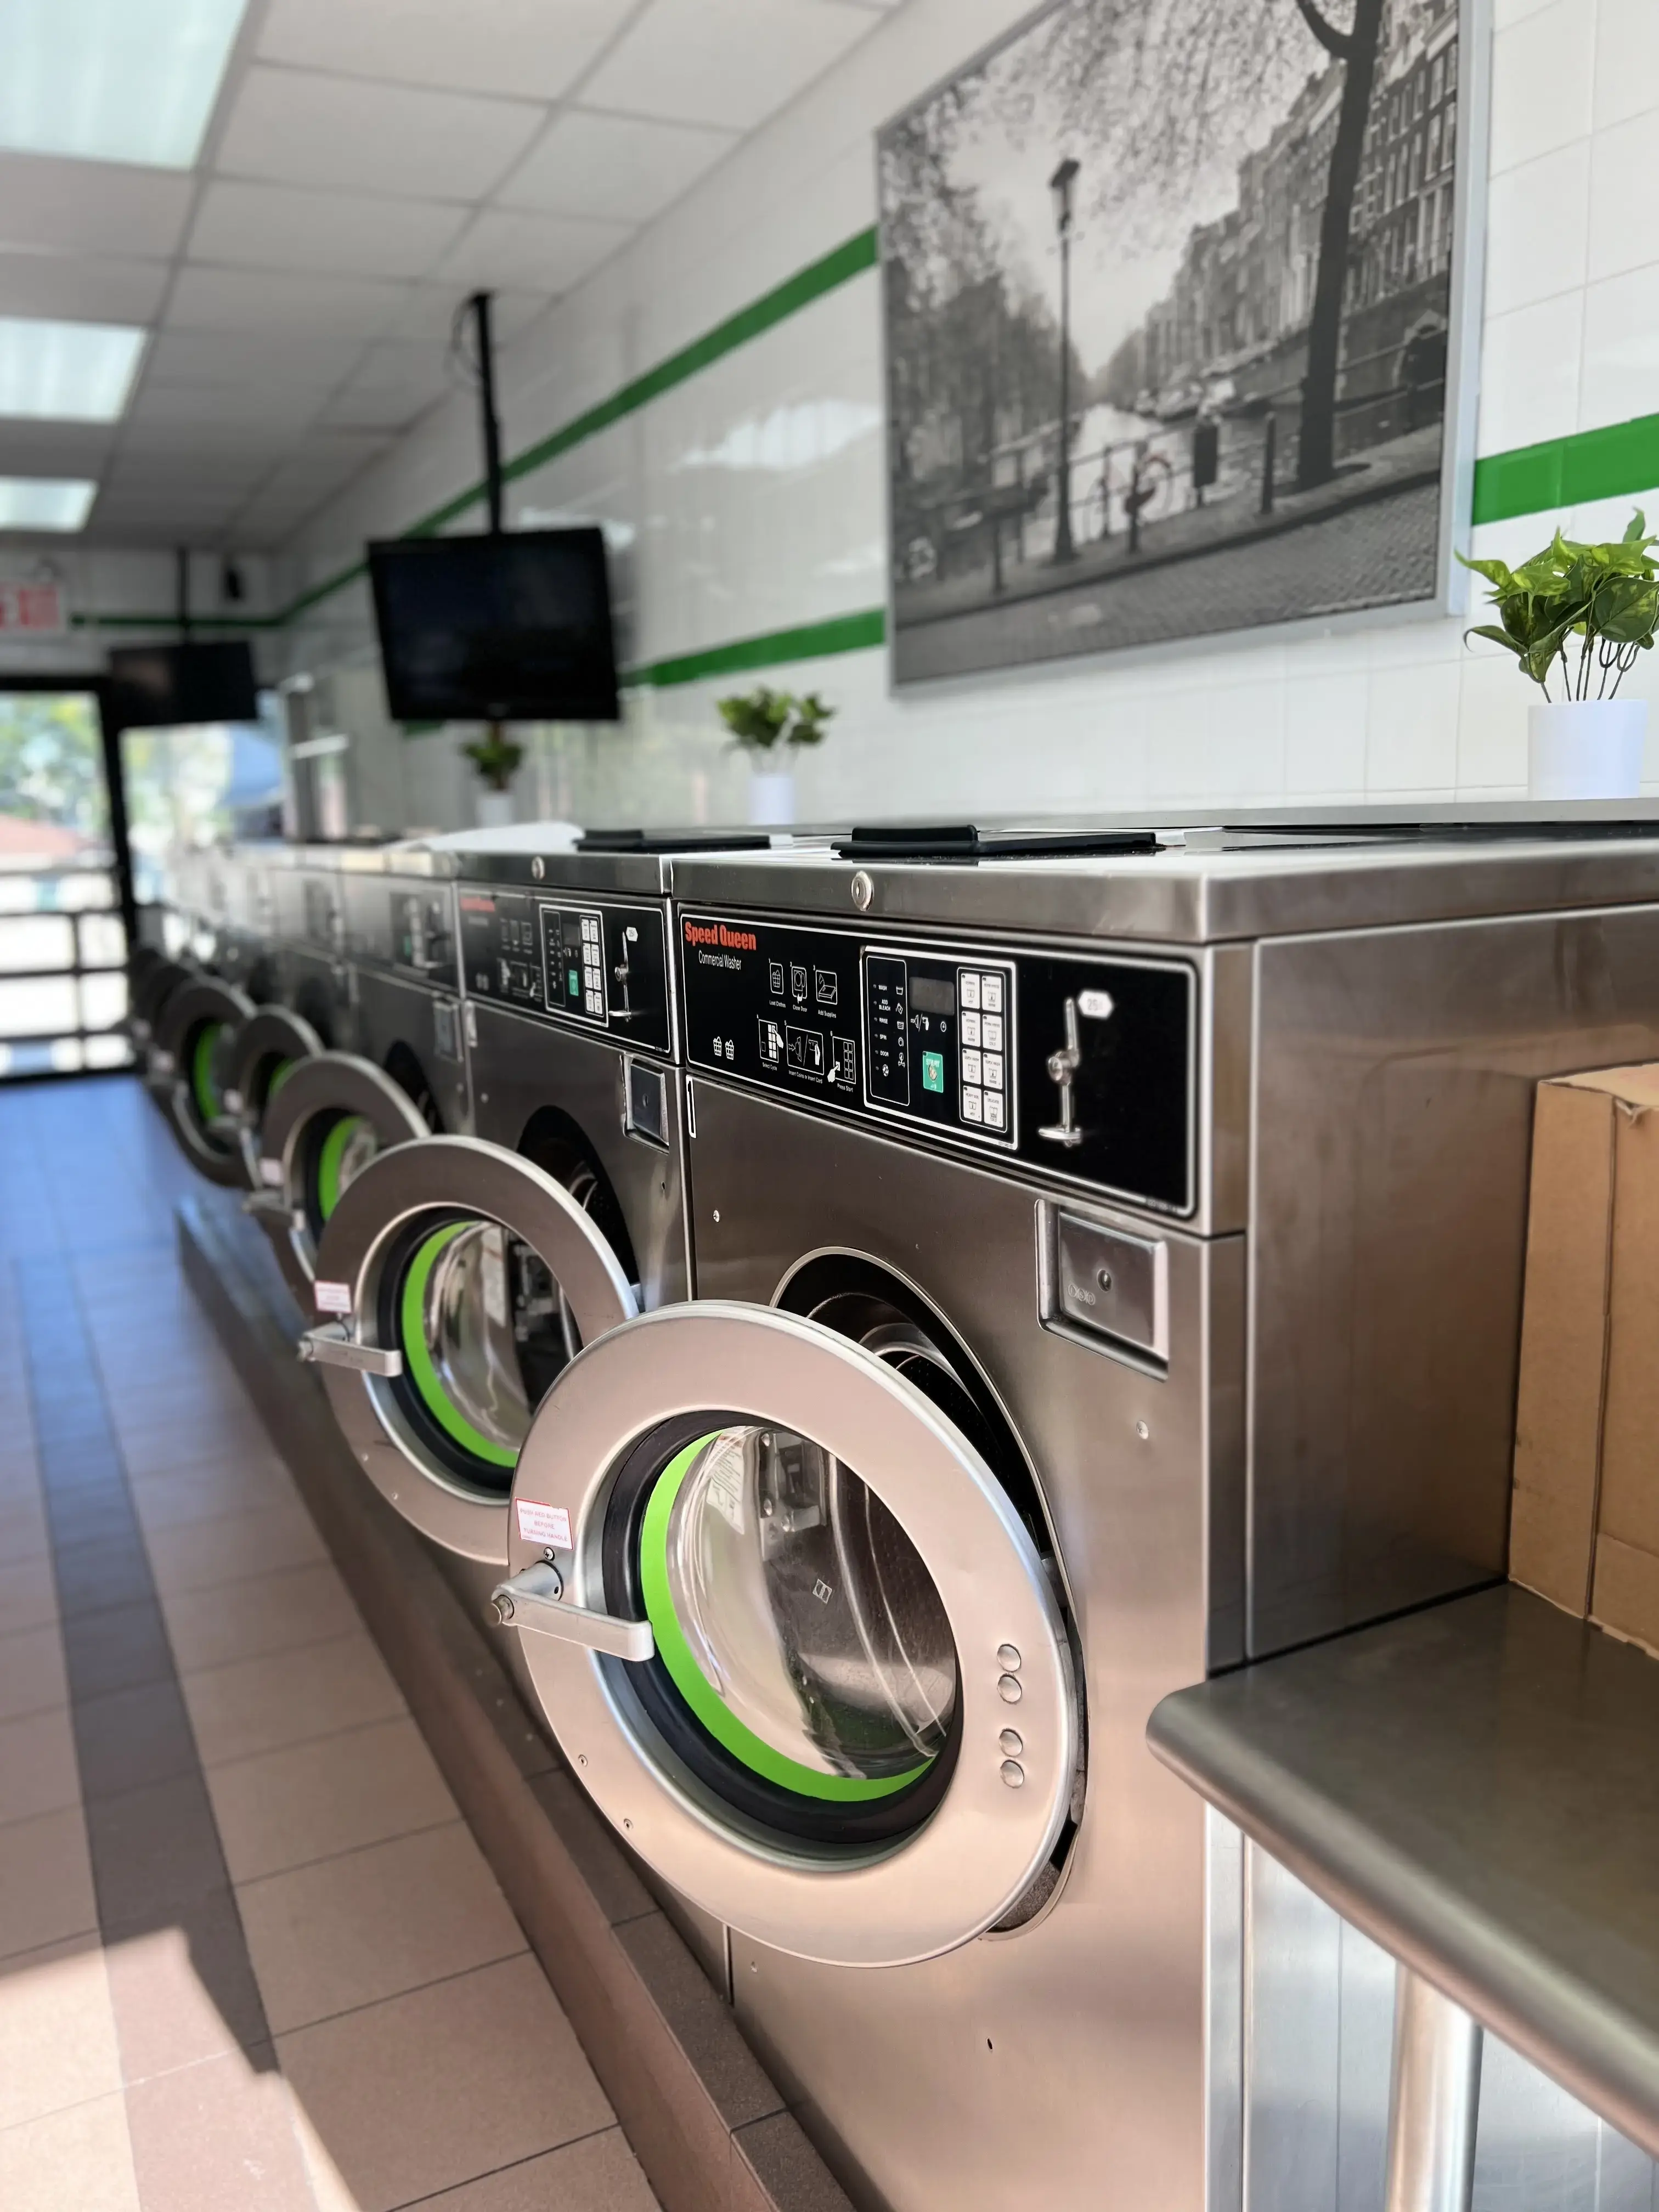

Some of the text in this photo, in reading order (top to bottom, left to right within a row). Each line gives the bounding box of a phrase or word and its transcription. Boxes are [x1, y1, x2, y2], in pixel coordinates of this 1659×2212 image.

[685, 921, 757, 951] Speed Queen
[698, 950, 742, 970] Commercial Washer
[520, 1508, 533, 1516] PUSH
[546, 1513, 567, 1522] BUTTON
[534, 1520, 555, 1530] BEFORE
[523, 1527, 568, 1542] TURNING HANDLE
